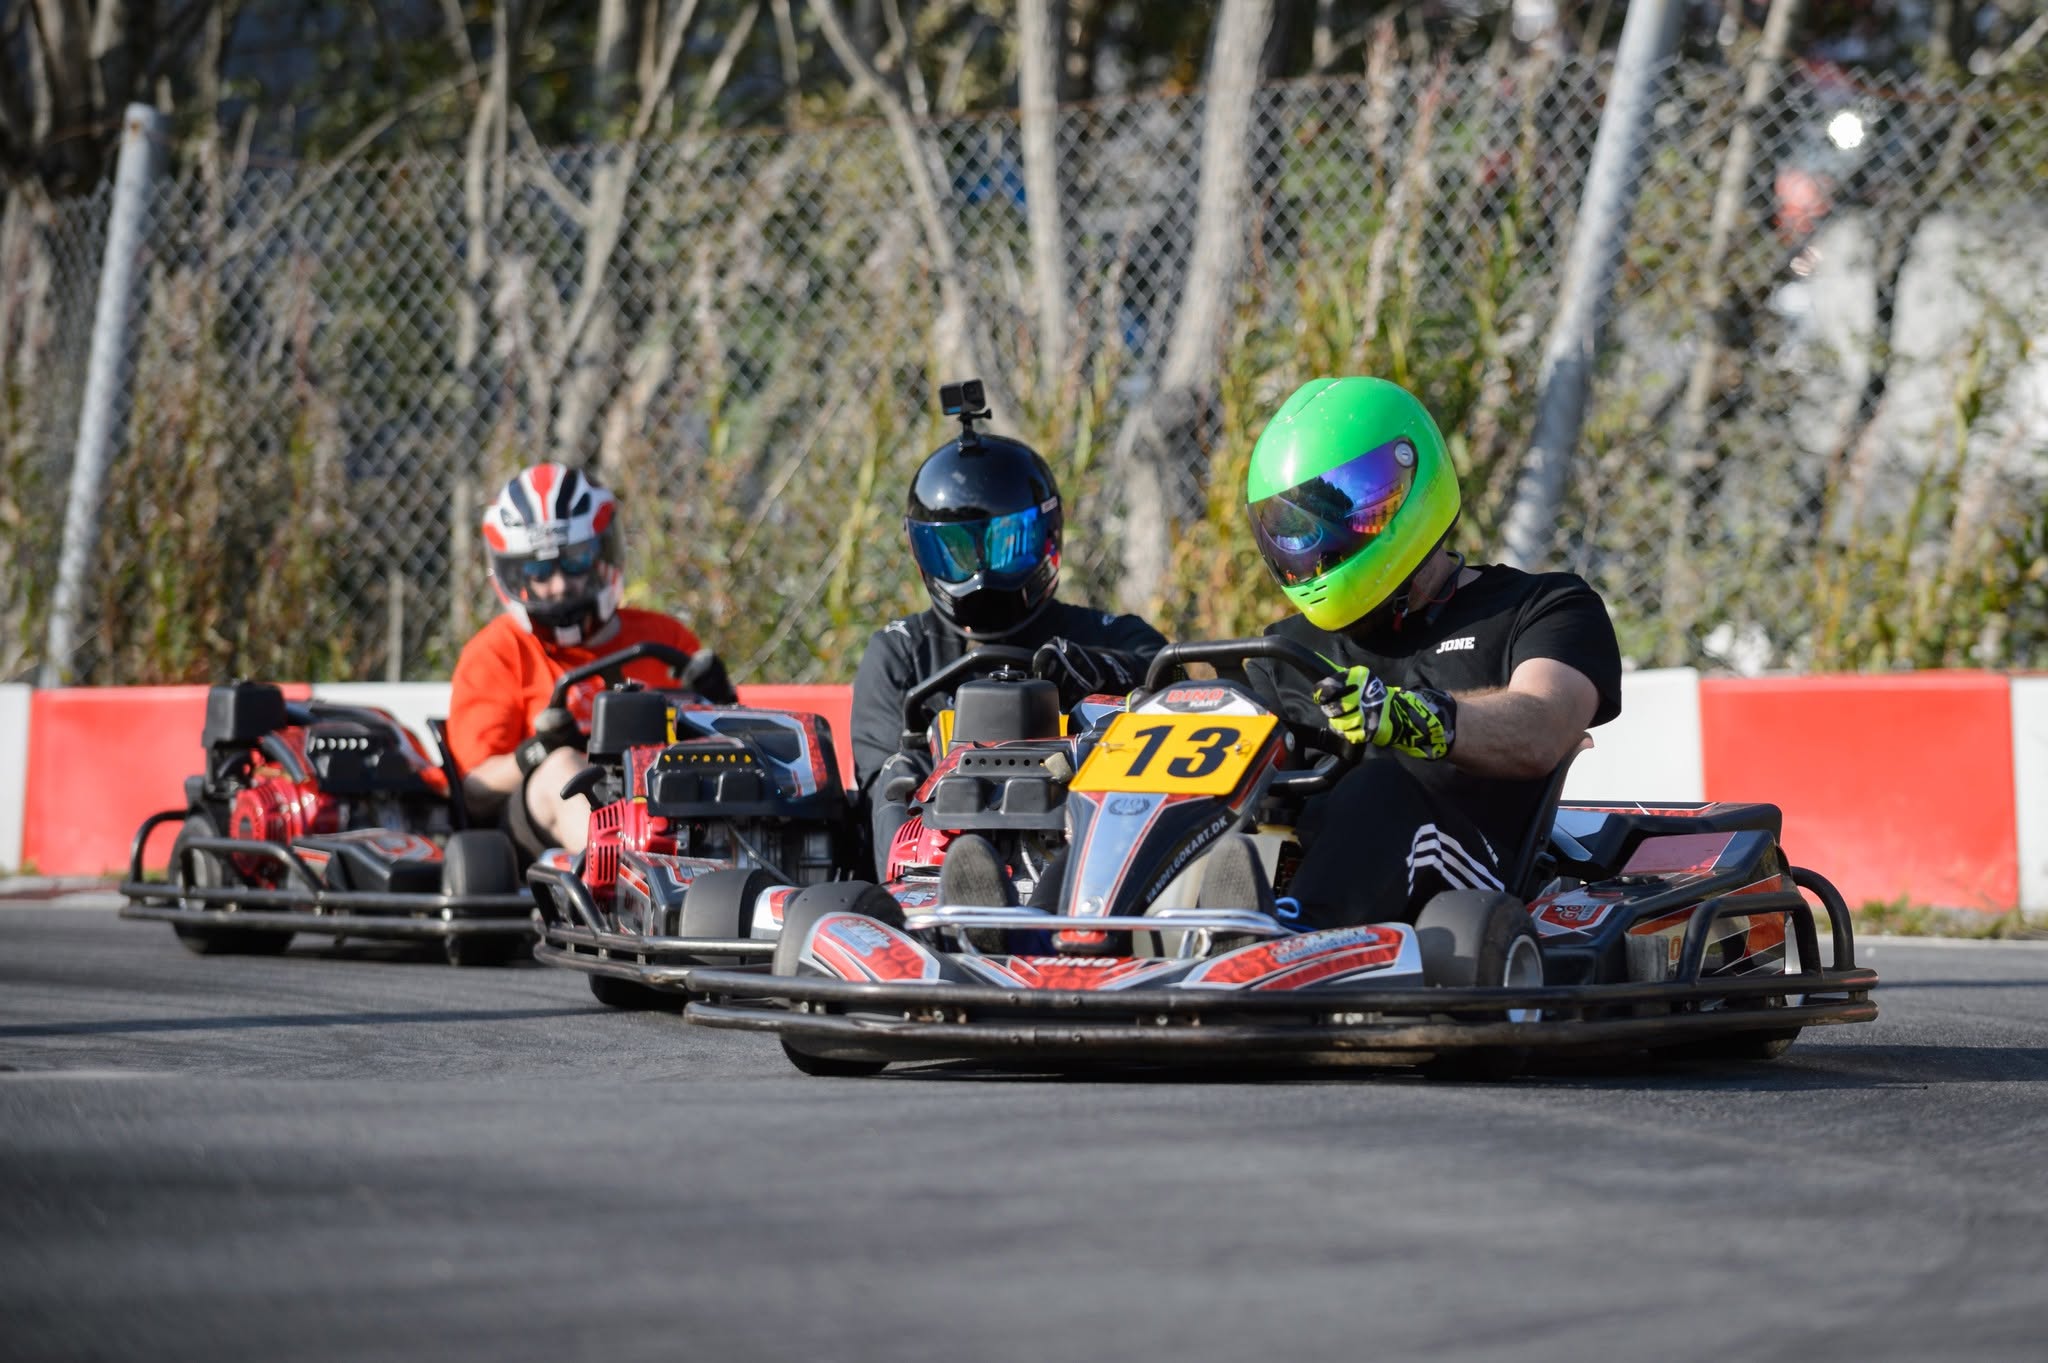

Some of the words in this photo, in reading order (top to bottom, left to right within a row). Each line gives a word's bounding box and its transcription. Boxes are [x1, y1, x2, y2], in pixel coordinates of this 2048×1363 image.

[1436, 636, 1476, 654] JONE
[1166, 688, 1225, 703] DINO
[1124, 724, 1241, 778] 13
